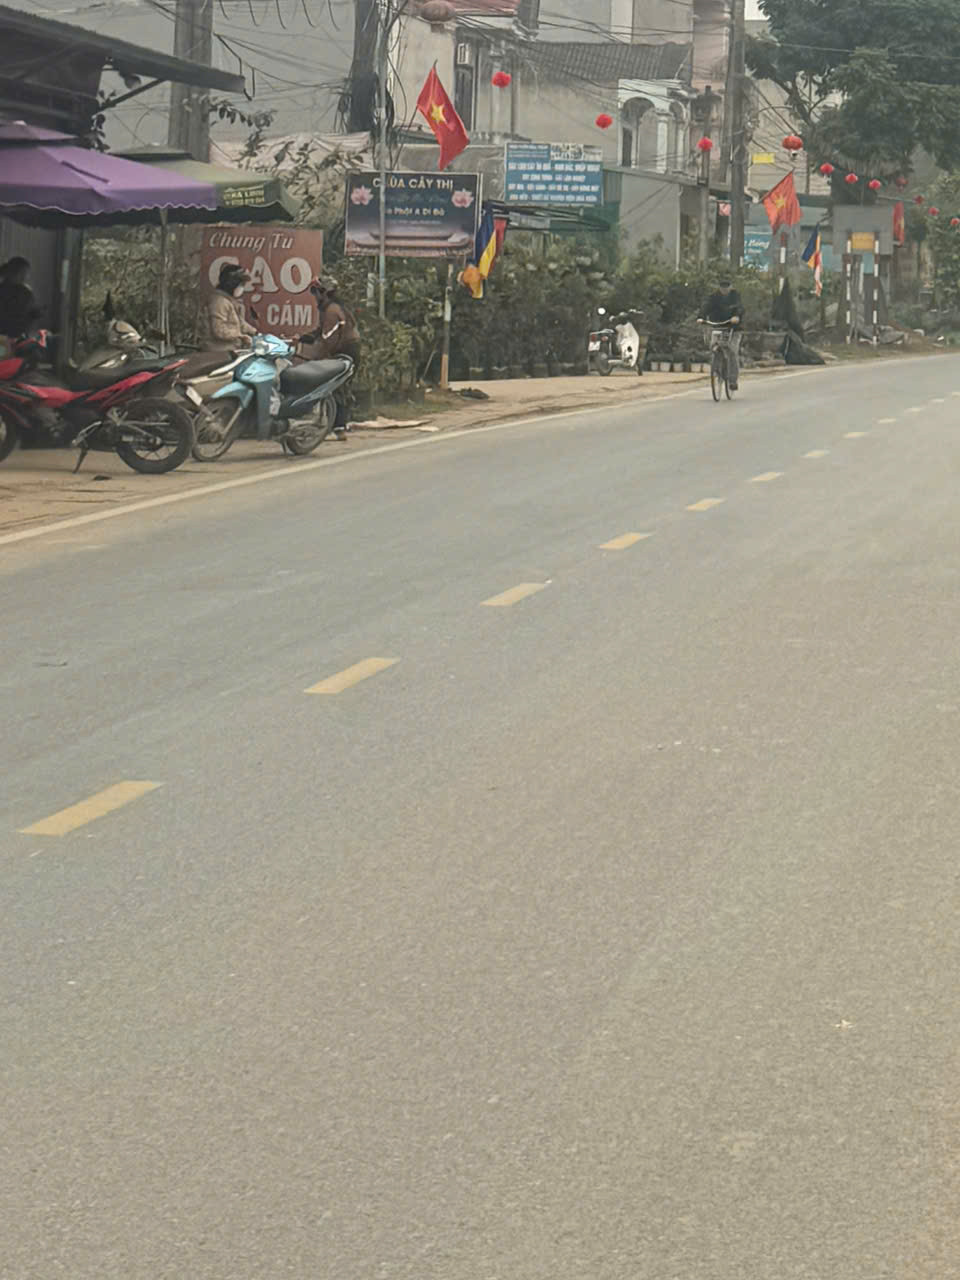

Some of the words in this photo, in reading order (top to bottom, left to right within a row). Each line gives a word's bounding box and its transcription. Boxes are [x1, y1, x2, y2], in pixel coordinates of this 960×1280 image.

[372, 176, 405, 188] CÙA
[408, 176, 433, 189] CÂY
[209, 232, 266, 253] Chung
